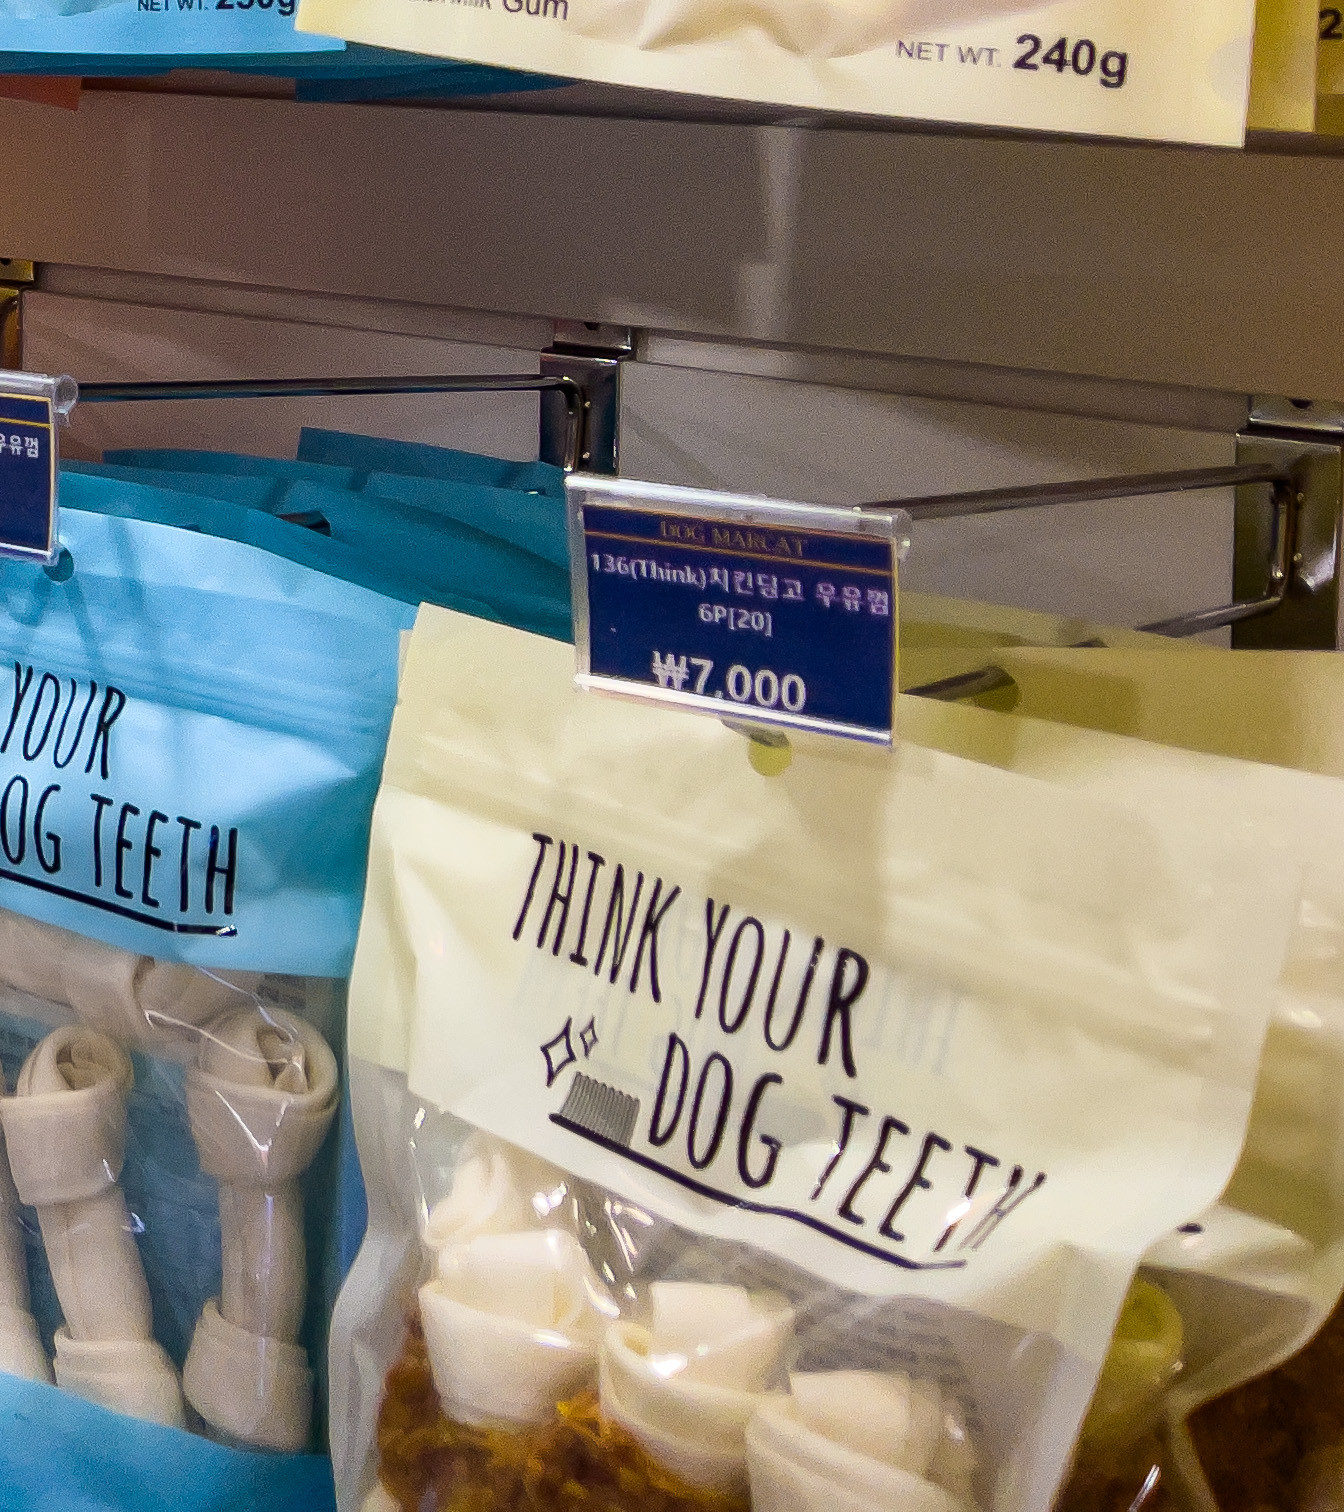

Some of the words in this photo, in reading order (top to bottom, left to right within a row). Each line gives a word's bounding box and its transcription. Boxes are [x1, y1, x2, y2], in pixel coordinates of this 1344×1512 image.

[896, 38, 950, 66] NET
[1012, 32, 1129, 89] 240g
[698, 603, 773, 638] 6P[20]
[816, 581, 889, 616] 우유껌
[0, 659, 125, 779] YOUR
[90, 792, 238, 915] TEETH
[511, 831, 683, 1003] THINK
[693, 898, 869, 1078] YOUR
[647, 1033, 784, 1189] DOG
[809, 1093, 1046, 1253] TEETH
